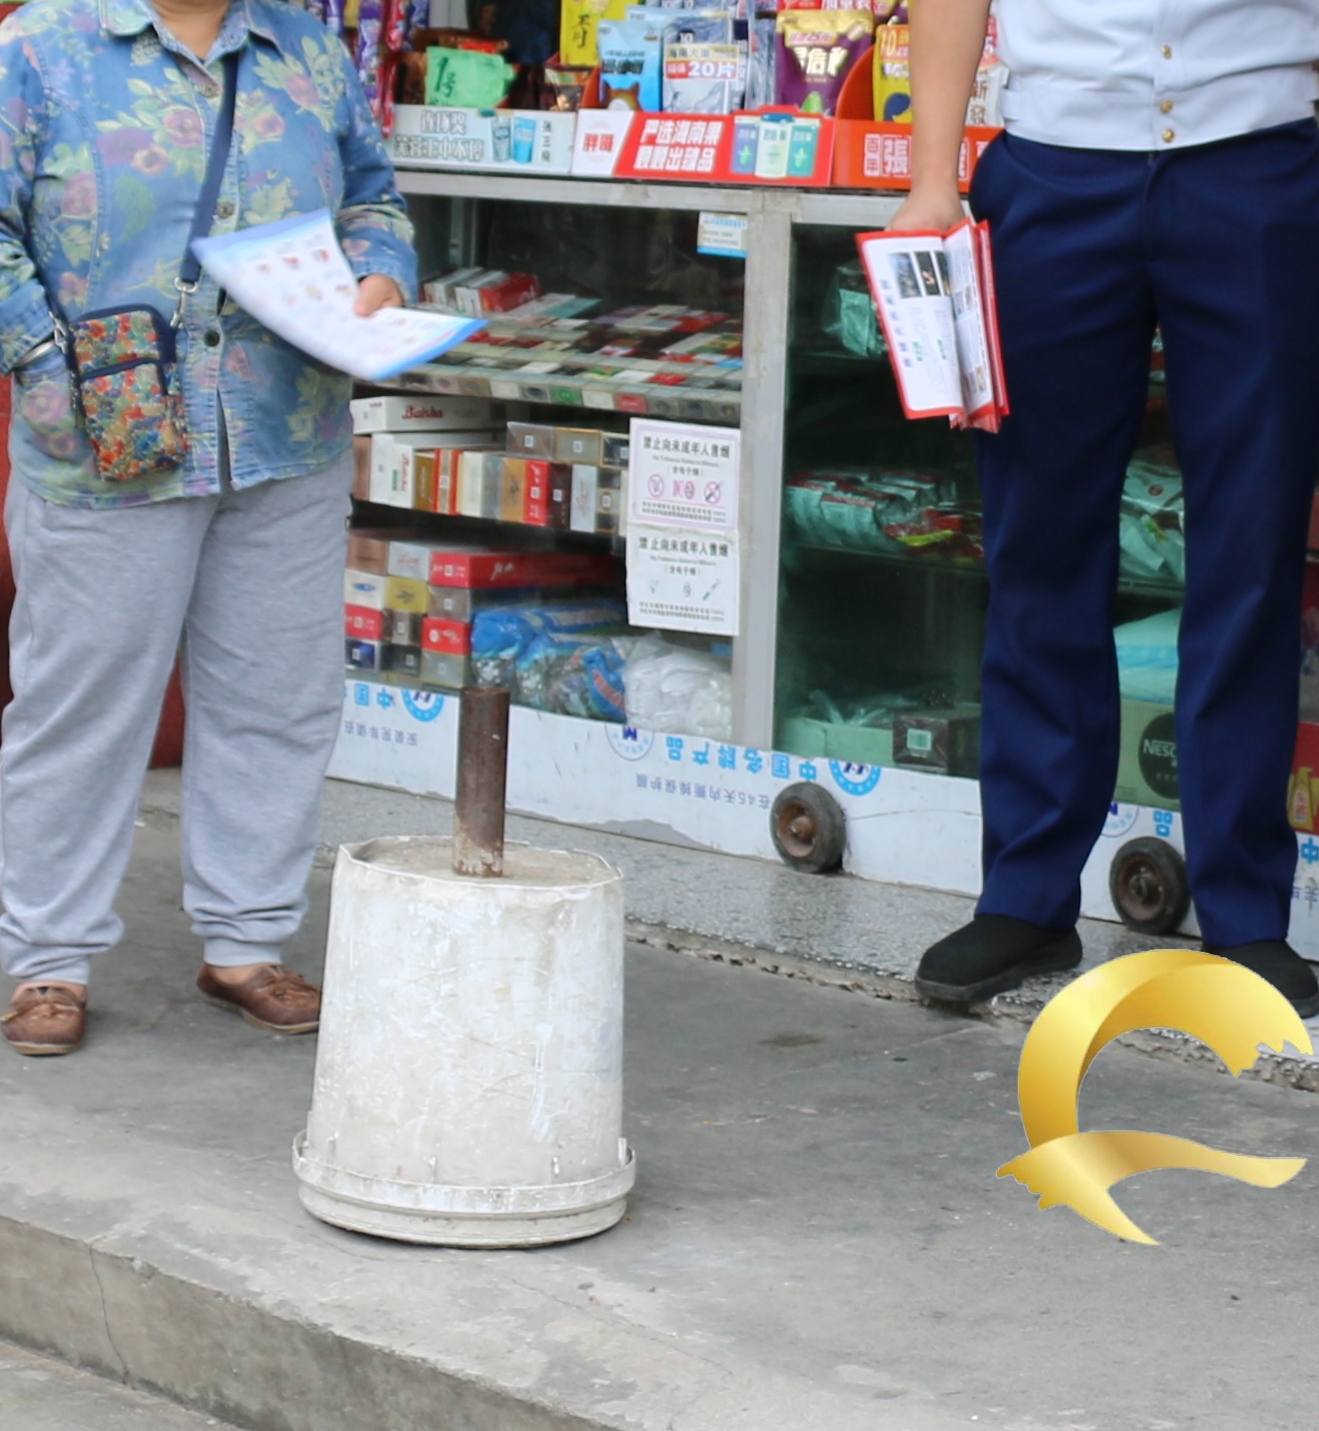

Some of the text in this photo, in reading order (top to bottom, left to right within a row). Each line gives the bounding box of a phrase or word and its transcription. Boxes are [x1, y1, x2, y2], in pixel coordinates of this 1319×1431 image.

[582, 133, 614, 153] 胖哥
[640, 119, 724, 145] 严选海南果
[643, 436, 730, 459] 禁止向未成年人售烟
[639, 536, 728, 557] 禁止向未成年人售烟
[665, 735, 817, 782] 中国名牌产品
